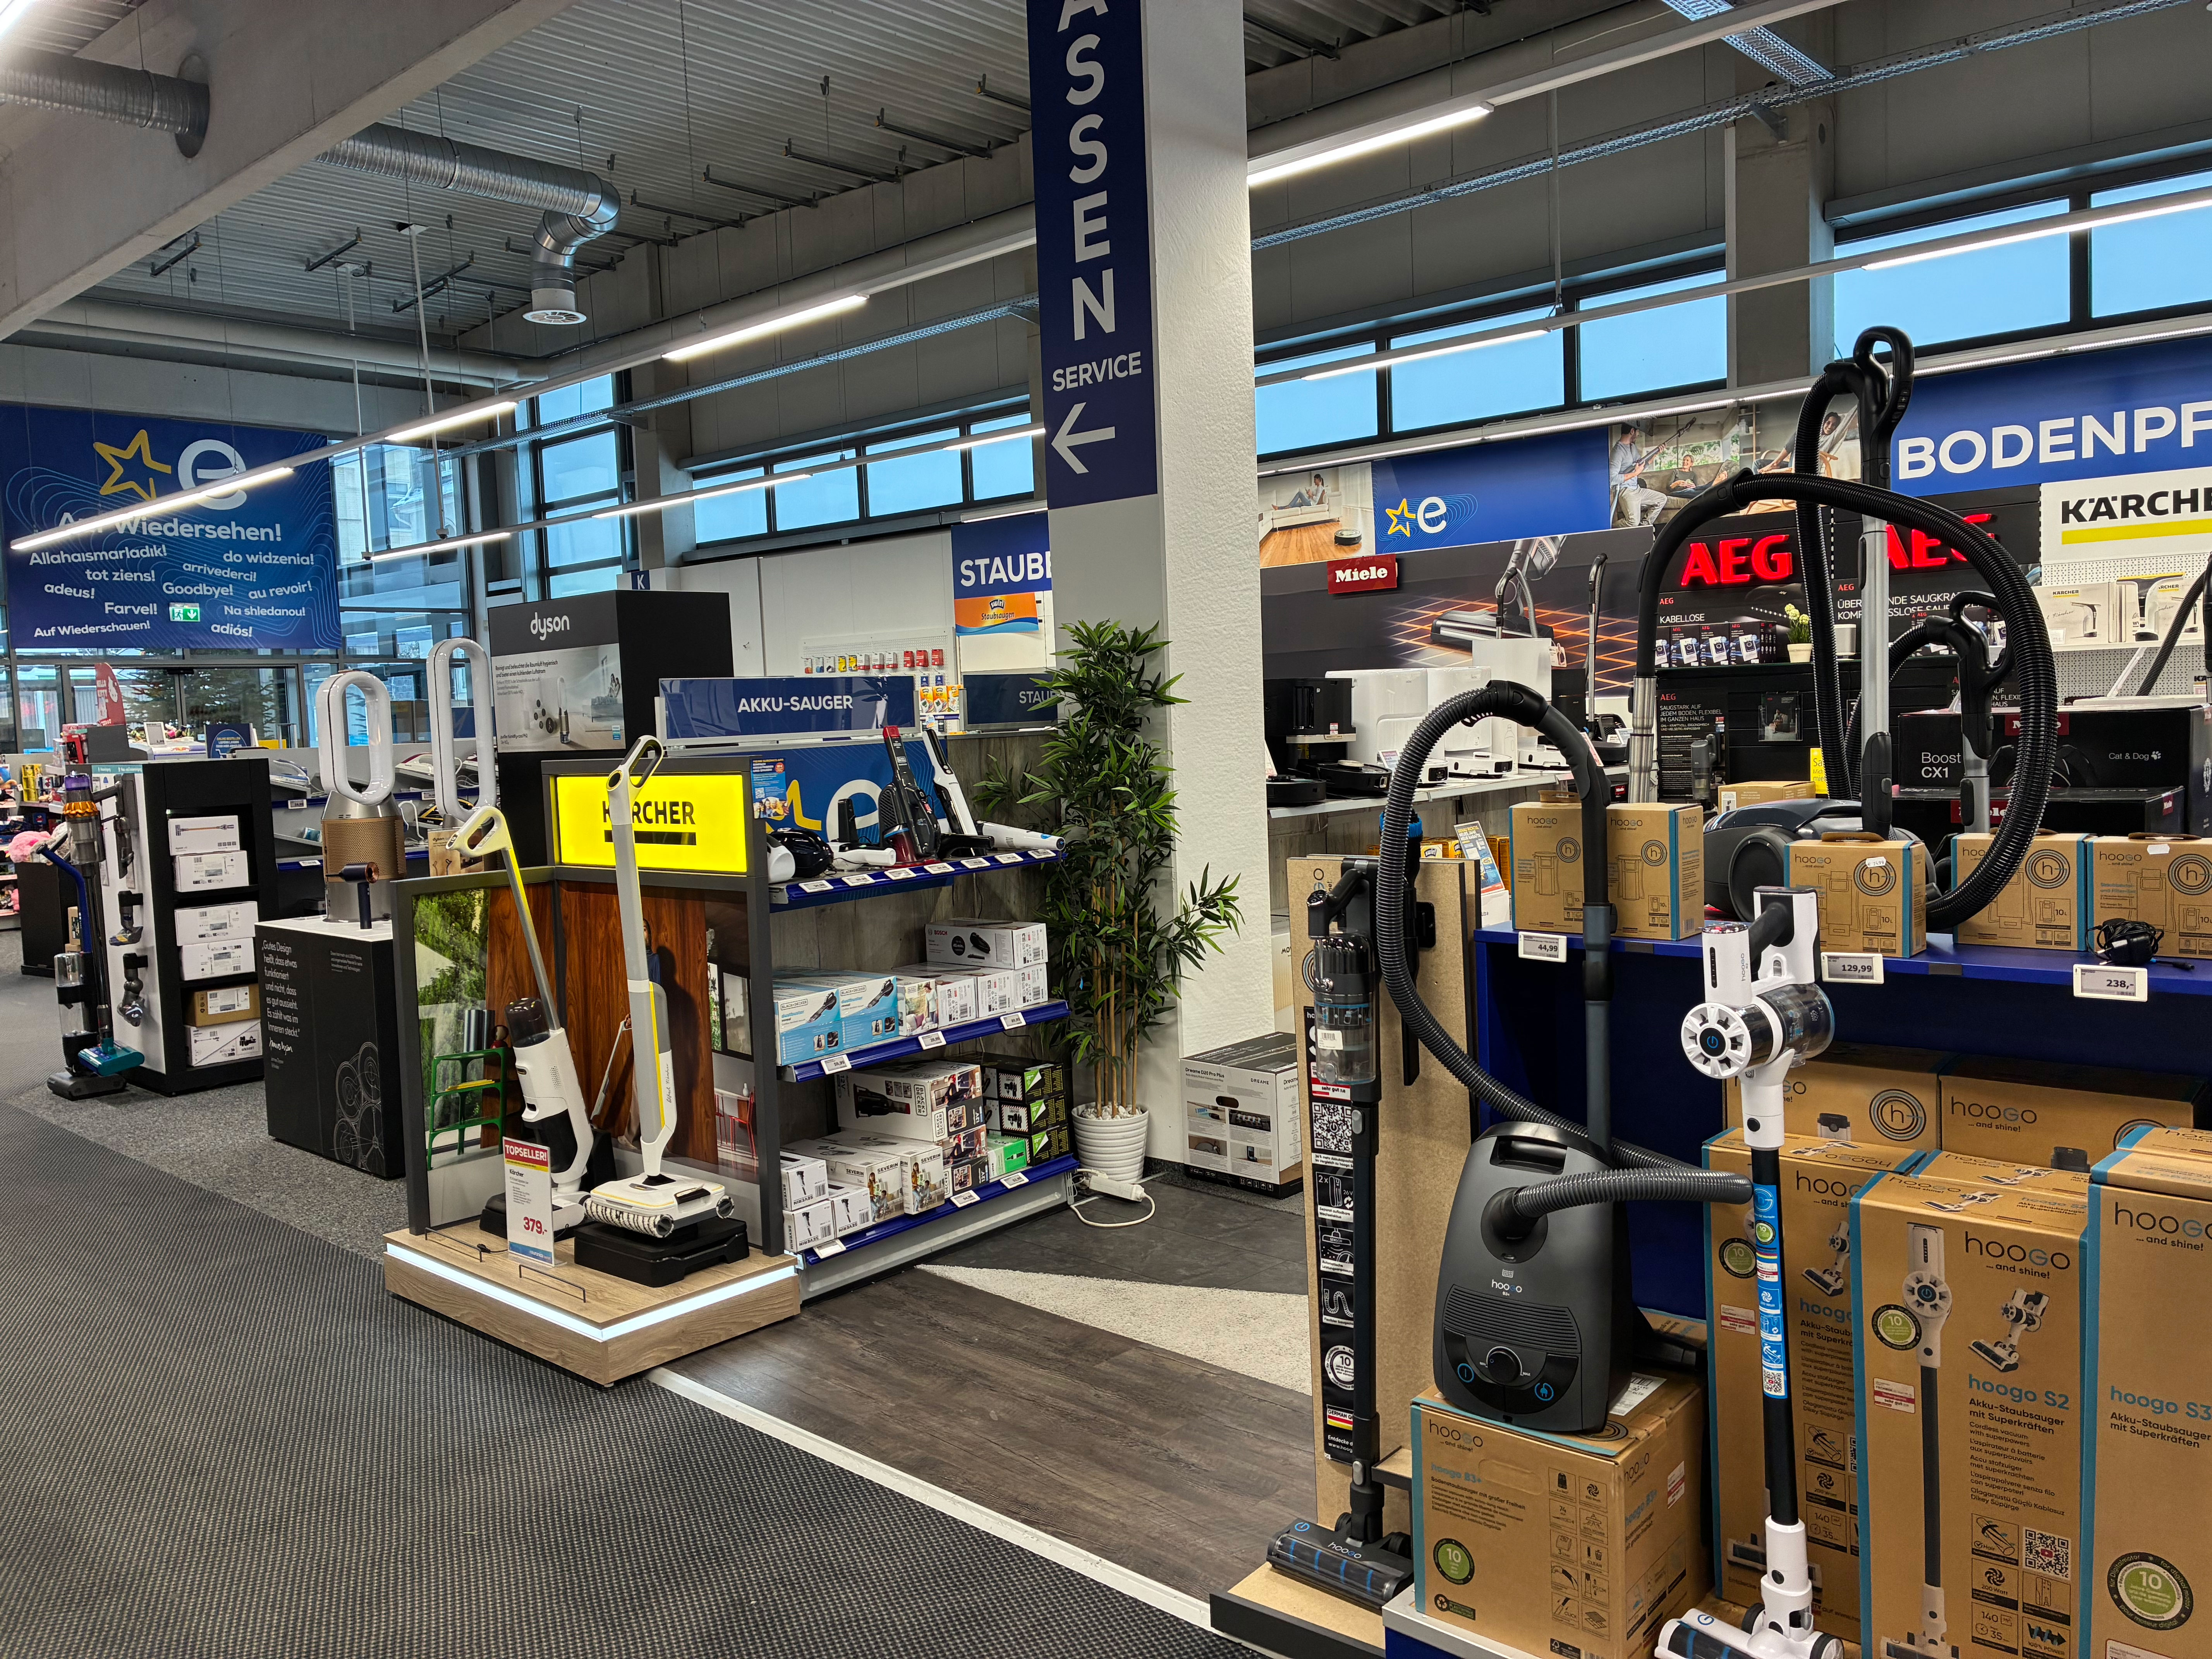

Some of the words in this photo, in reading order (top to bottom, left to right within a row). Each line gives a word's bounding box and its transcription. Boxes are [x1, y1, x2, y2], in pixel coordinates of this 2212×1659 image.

[1053, 351, 1142, 392] SERVICE
[1899, 401, 2212, 480] BODENPF
[223, 550, 242, 563] do
[246, 551, 314, 565] widzenia!
[1681, 534, 1792, 586] AEG
[85, 569, 109, 580] tot
[112, 570, 156, 582] ziens!
[182, 562, 257, 582] arrivederci!
[1335, 565, 1388, 583] Miele
[637, 574, 646, 589] K
[44, 584, 95, 599] adeus!
[163, 582, 234, 598] Goodbye!
[248, 589, 266, 600] au
[269, 581, 313, 598] revoir!
[105, 602, 158, 615] Farvel!
[224, 606, 242, 615] Na
[244, 606, 306, 617] shledanou!
[991, 599, 1005, 610] swirl
[981, 612, 1015, 620] Staubsaugen
[1660, 613, 1705, 624] KABELLOSE
[34, 627, 55, 637] Auf
[59, 621, 151, 635] Wiederschauen!
[211, 623, 252, 637] adiós!
[530, 612, 570, 641] dyson
[737, 694, 853, 713] AKKU-SAUGER
[1922, 752, 1961, 764] Boost
[2133, 752, 2149, 762] Dog
[1922, 766, 1949, 778] CX1
[602, 800, 696, 824] KRCHER
[276, 942, 292, 955] Design
[1538, 944, 1558, 952] 44,99
[275, 957, 285, 966] dass
[1841, 964, 1872, 973] 129,99
[265, 981, 274, 991] und
[286, 986, 297, 996] dass
[2106, 979, 2135, 989] 238,-
[267, 1008, 272, 1018] Es
[292, 1013, 298, 1023] im
[1995, 1122, 2021, 1132] shine!
[505, 1144, 547, 1162] TOPSELLER!
[921, 1153, 941, 1163] SEVERIN
[877, 1162, 899, 1173] SEVERIN
[1796, 1170, 1864, 1196] hooG
[523, 1216, 548, 1235] 379,-
[2171, 1238, 2203, 1251] shine!
[2019, 1267, 2050, 1279] shine!
[1888, 1315, 1903, 1326] 10
[1340, 1356, 1351, 1367] 10
[1968, 1374, 2037, 1403] hoogo
[2045, 1391, 2069, 1410] S2
[2111, 1385, 2179, 1414] hoogo
[2186, 1401, 2212, 1421] S3
[1328, 1410, 1347, 1419] GERMAN
[1969, 1398, 2065, 1426] Akku-Staubsauger
[1970, 1410, 1985, 1419] mit
[1989, 1412, 2054, 1435] Superkräften
[2110, 1412, 2212, 1441] Akku-Staubsauger
[1970, 1421, 1999, 1434] Cordless
[2000, 1429, 2028, 1440] vacuum
[1970, 1429, 1984, 1437] with
[1985, 1432, 2030, 1447] superpowers
[2110, 1422, 2128, 1432] mit
[2130, 1425, 2200, 1448] Superkräften
[1328, 1435, 1349, 1445] Entdecke
[1457, 1443, 1473, 1453] shine!
[2017, 1448, 2045, 1461] batterie
[1970, 1454, 1987, 1463] Accu
[1989, 1459, 2022, 1472] stofzuiger
[1985, 1448, 2033, 1465] superpouvoirs
[1985, 1464, 2035, 1482] superkrachten
[1431, 1476, 1478, 1495] Bodenstaubsauger
[1488, 1494, 1505, 1504] großer
[1506, 1499, 1525, 1510] Freiheit
[1985, 1481, 2024, 1496] superpoteri
[2023, 1484, 2043, 1494] senza
[2045, 1489, 2055, 1497] filo
[2034, 1502, 2065, 1516] Kablosuz
[1814, 1512, 1830, 1522] 140
[1822, 1529, 1834, 1539] 35
[1446, 1548, 1462, 1563] 10
[2139, 1571, 2162, 1590] 10
[1981, 1584, 1992, 1592] 200
[1993, 1587, 2008, 1596] Watt
[1981, 1611, 1999, 1623] 140
[1990, 1631, 2003, 1641] 35
